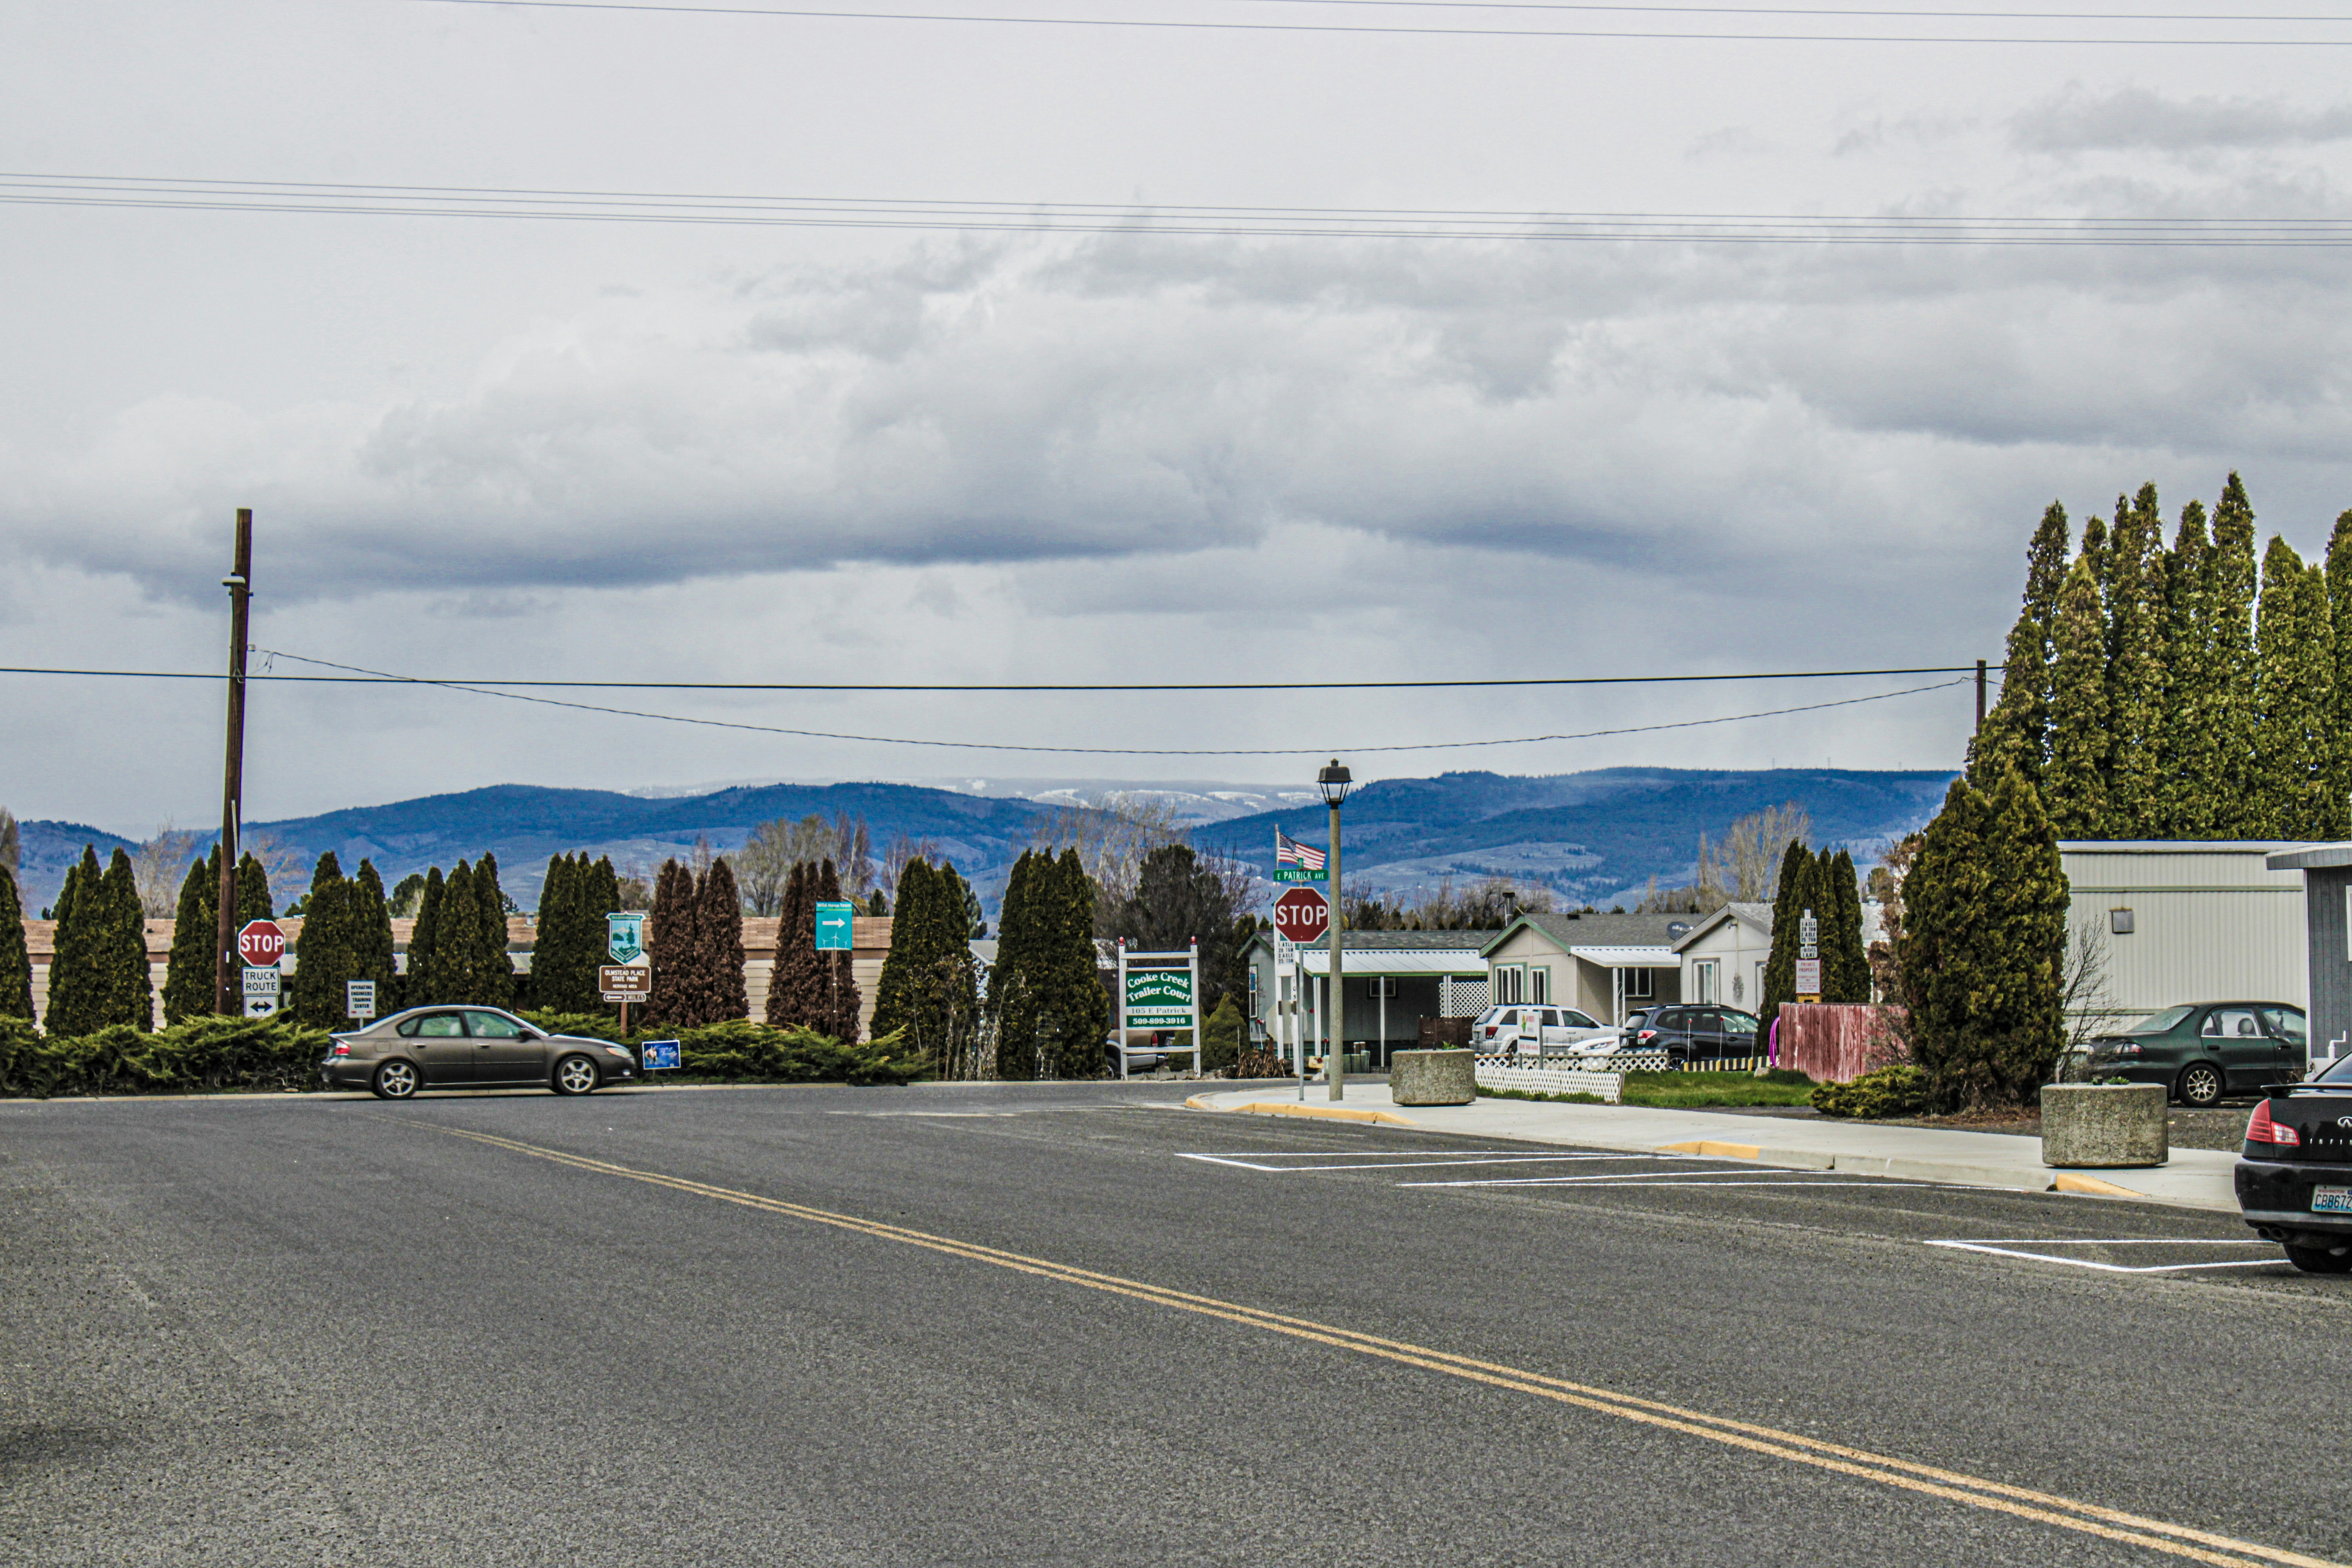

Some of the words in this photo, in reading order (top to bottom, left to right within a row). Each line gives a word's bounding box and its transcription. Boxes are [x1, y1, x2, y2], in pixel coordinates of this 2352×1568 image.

[1284, 871, 1311, 880] PATRICK
[1276, 905, 1327, 926] STOP
[241, 935, 284, 952] STOP
[245, 971, 276, 980] TRUCK
[1127, 973, 1158, 988] Cooke
[1160, 972, 1189, 989] Creek
[246, 982, 276, 991] ROUTE
[1127, 987, 1161, 1002] Trailer
[1163, 986, 1191, 1002] Court
